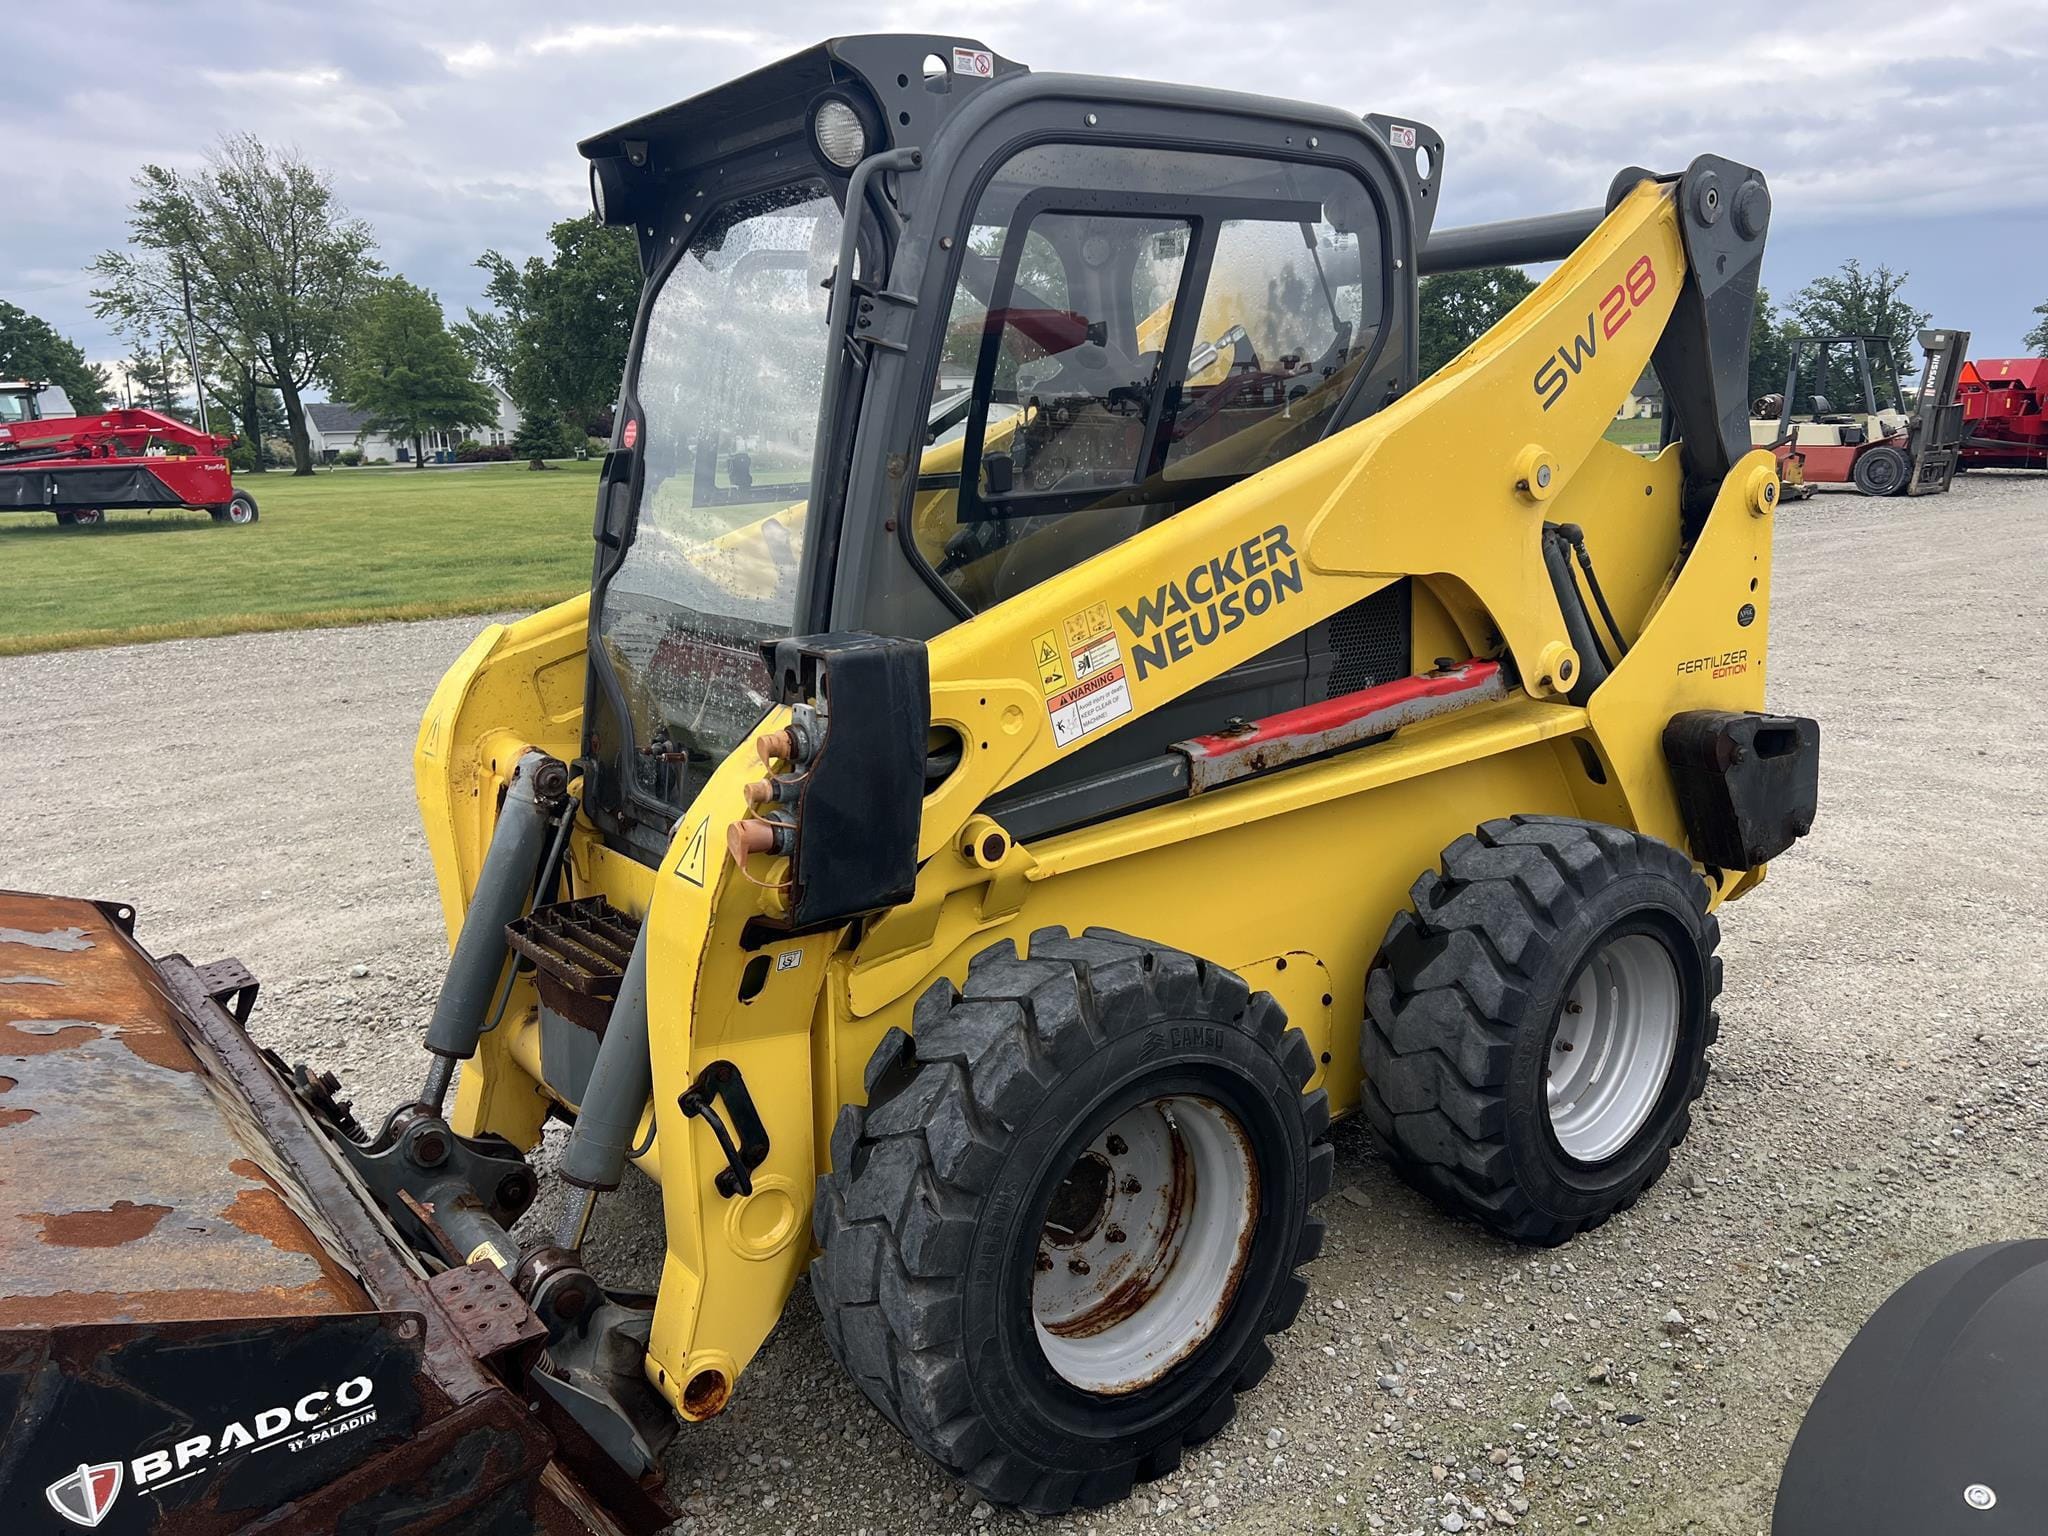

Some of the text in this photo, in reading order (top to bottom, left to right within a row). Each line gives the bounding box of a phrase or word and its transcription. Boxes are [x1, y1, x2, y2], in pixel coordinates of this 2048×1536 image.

[1926, 354, 1941, 388] NISSAN
[1117, 525, 1296, 638] WACKER
[1131, 559, 1303, 681] NEUSON
[1677, 650, 1747, 675] FERTILIZER
[1713, 664, 1747, 679] EDITION
[1068, 672, 1115, 701] WARNING
[1081, 708, 1095, 719] KEEP
[1095, 699, 1112, 712] CLEAR
[1170, 1027, 1224, 1050] CAMSO
[131, 1376, 374, 1485] BRADCO
[309, 1411, 377, 1443] PALADIN
